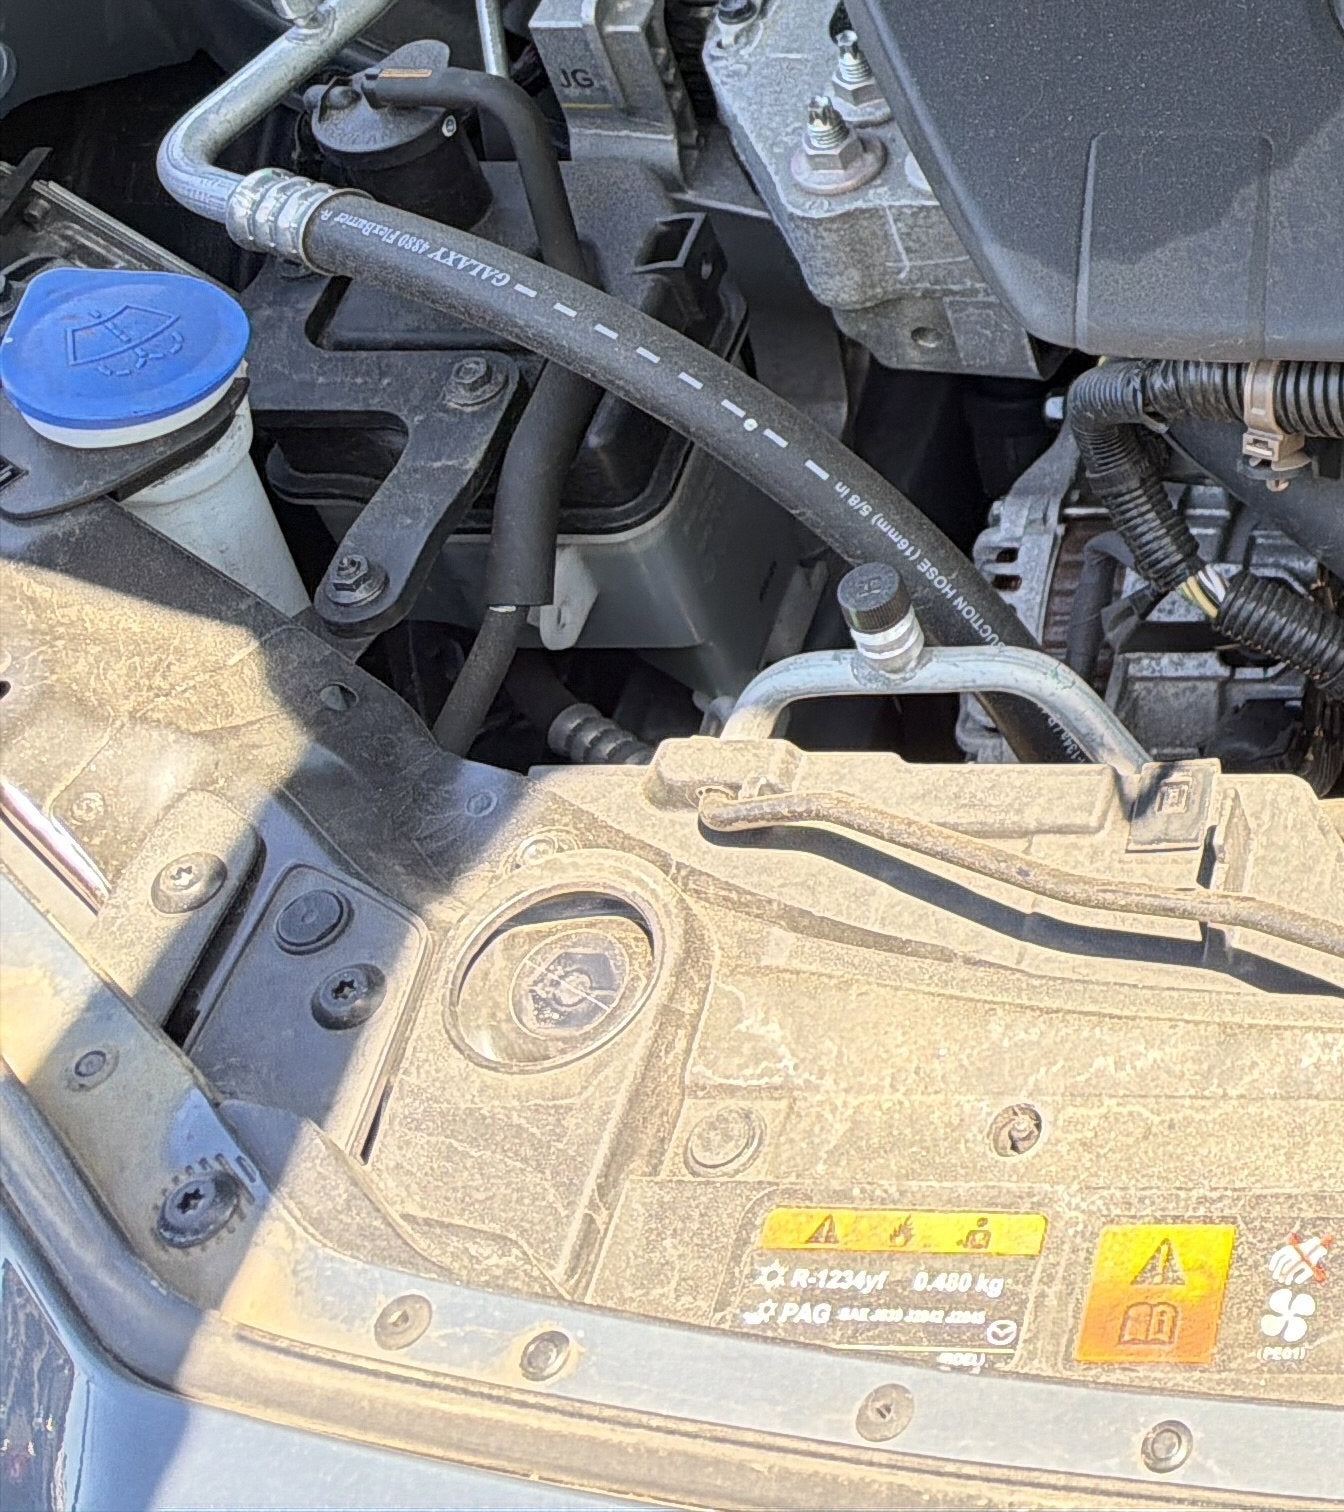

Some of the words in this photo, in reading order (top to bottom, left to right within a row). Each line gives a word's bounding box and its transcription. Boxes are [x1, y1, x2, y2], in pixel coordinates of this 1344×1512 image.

[560, 68, 594, 88] JG
[333, 211, 401, 245] FlexBarrier
[397, 233, 431, 255] 4880
[427, 246, 511, 287] GALAXY
[848, 494, 874, 518] 5/8
[871, 511, 922, 563] (16mm)
[915, 557, 959, 599] HOSE
[790, 1268, 891, 1294] R-1234yf
[975, 1273, 1004, 1298] kg
[778, 1303, 831, 1324] PAG
